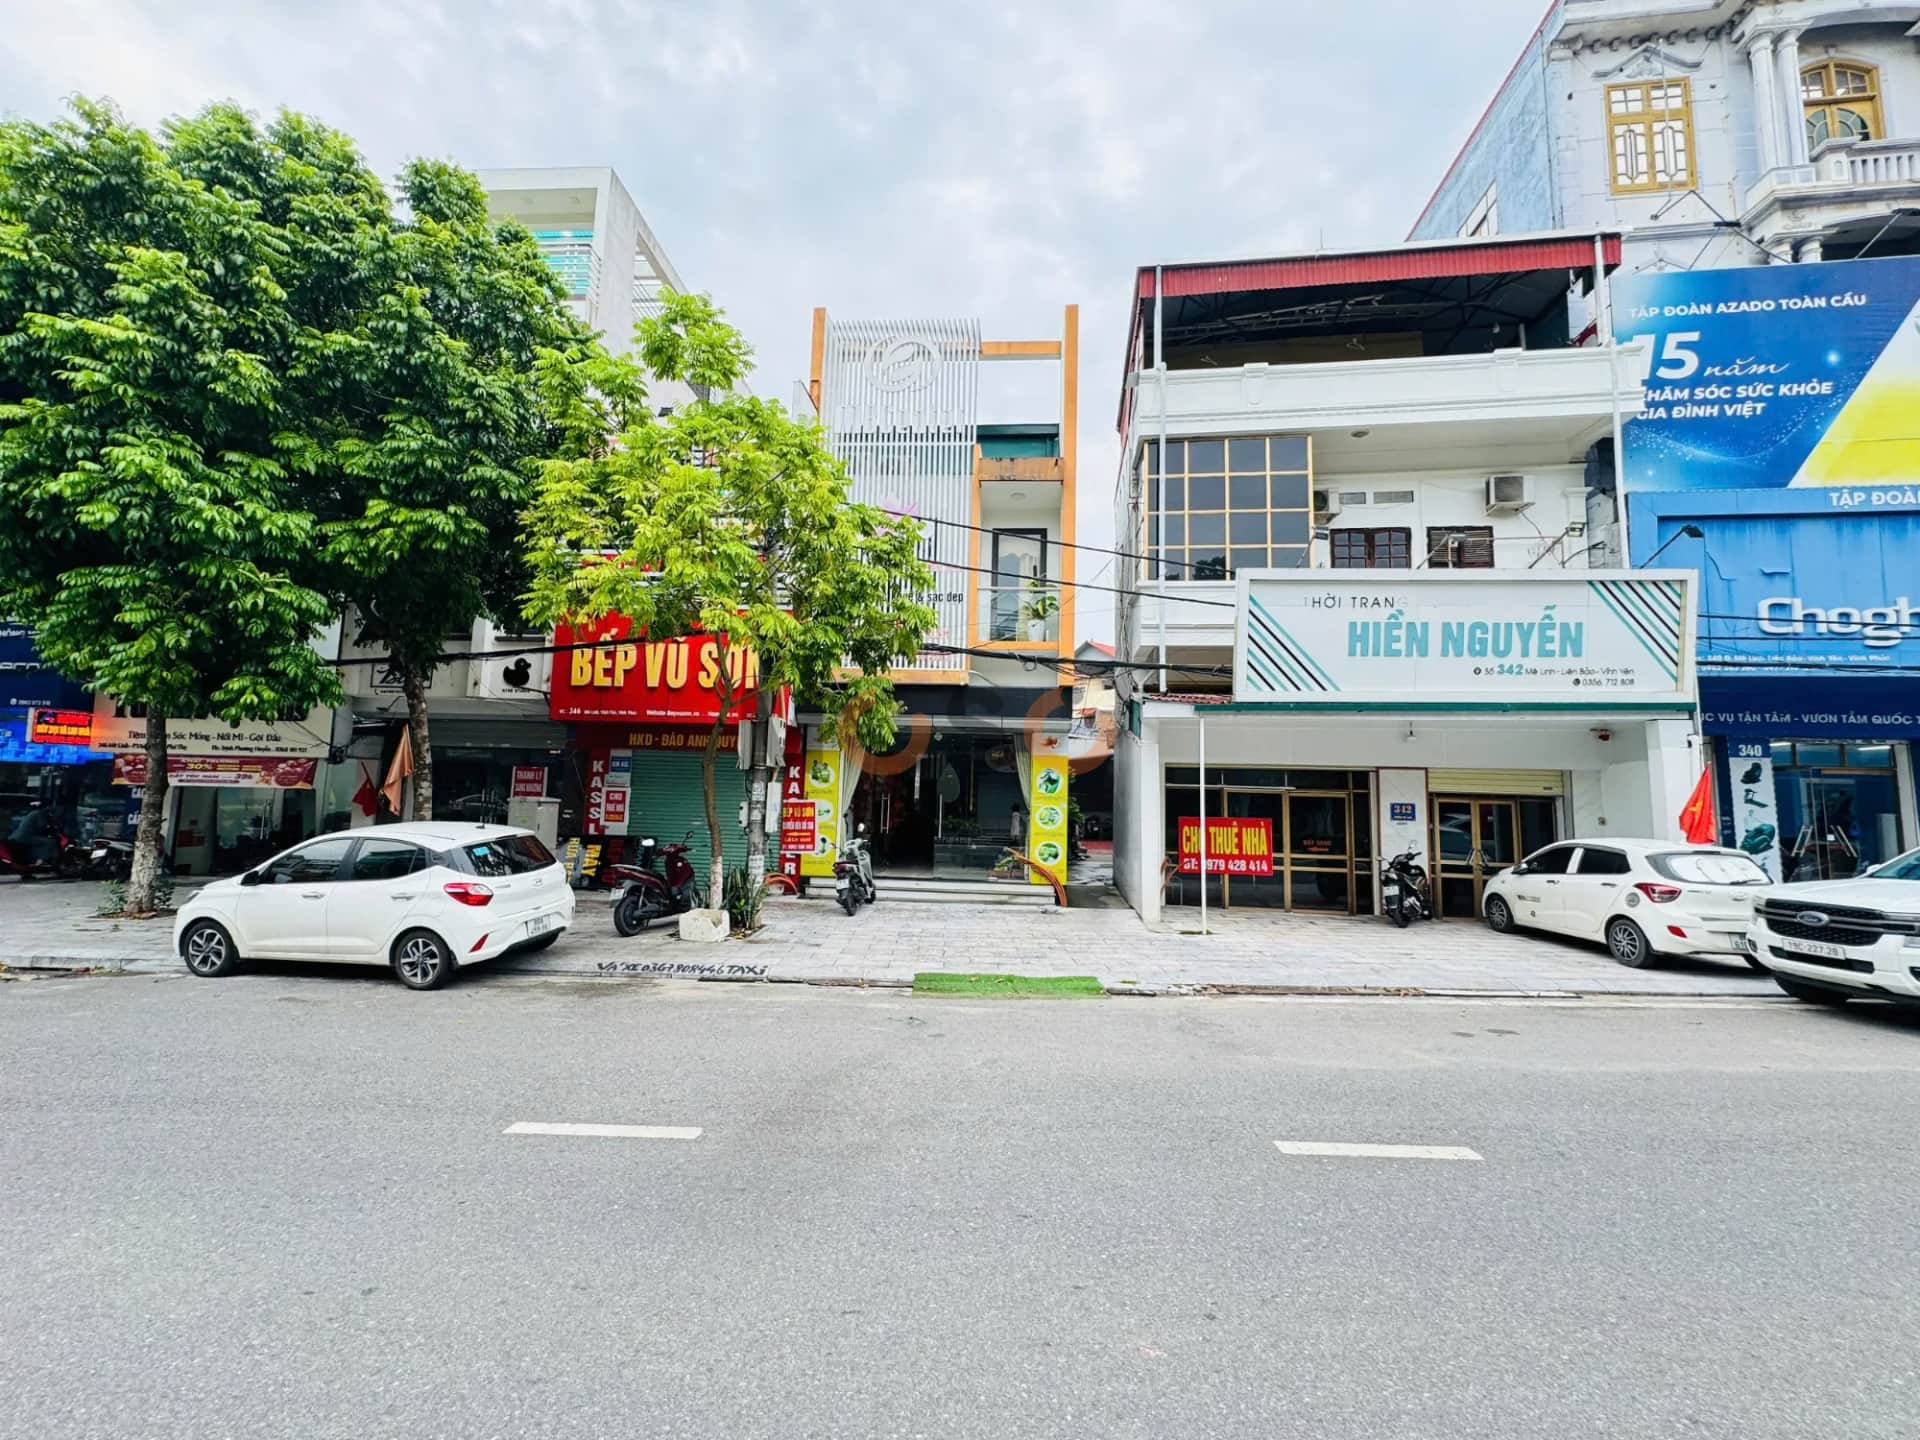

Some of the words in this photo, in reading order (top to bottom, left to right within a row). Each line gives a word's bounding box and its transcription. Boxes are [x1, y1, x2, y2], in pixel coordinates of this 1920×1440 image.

[1664, 302, 1712, 317] ĐOÀN
[1716, 300, 1775, 313] AZADO
[1779, 295, 1826, 310] TOÀN
[1704, 356, 1790, 377] năm
[1646, 386, 1690, 401] HĂM
[1694, 384, 1731, 400] SÓC
[1738, 381, 1774, 397] SỨC
[1779, 378, 1833, 396] KHỎE
[1672, 403, 1718, 418] ĐÌNH
[1724, 402, 1766, 419] VIỆT
[1829, 488, 1866, 509] TẬP
[1439, 603, 1584, 658] NGUYỄN
[570, 627, 637, 689] BẾP
[645, 636, 690, 689] VŨ
[1496, 663, 1525, 676] 342
[1737, 710, 1761, 725] TẬN
[1738, 744, 1763, 757] 340
[1182, 825, 1201, 855] CH
[1209, 820, 1240, 855] THUÊ
[1242, 820, 1268, 856] NHÀ
[1227, 858, 1247, 872] 428
[1248, 860, 1268, 873] 414
